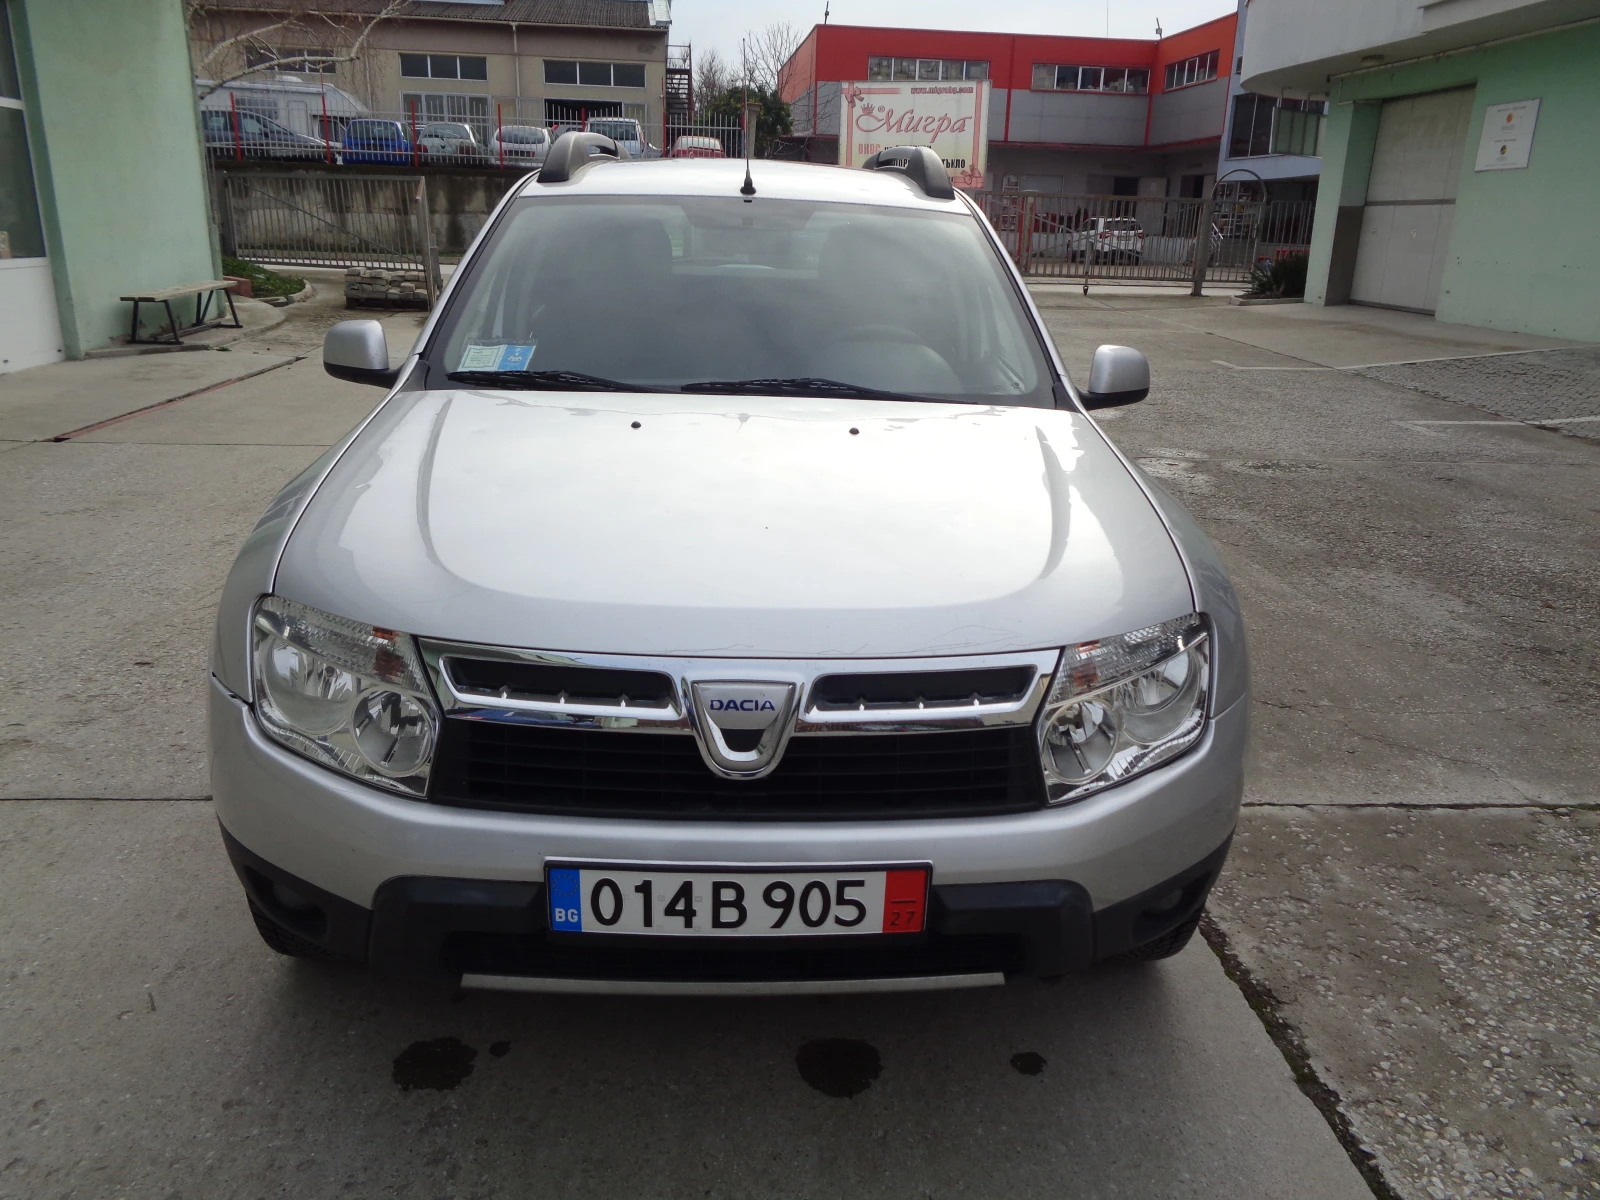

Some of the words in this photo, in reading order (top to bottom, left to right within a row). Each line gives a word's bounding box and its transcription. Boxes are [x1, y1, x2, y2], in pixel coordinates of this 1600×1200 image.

[858, 143, 880, 155] ВНОС
[941, 158, 966, 169] ТЪКЛО
[710, 699, 775, 711] DACIA
[554, 907, 579, 923] BG
[890, 910, 916, 927] 27
